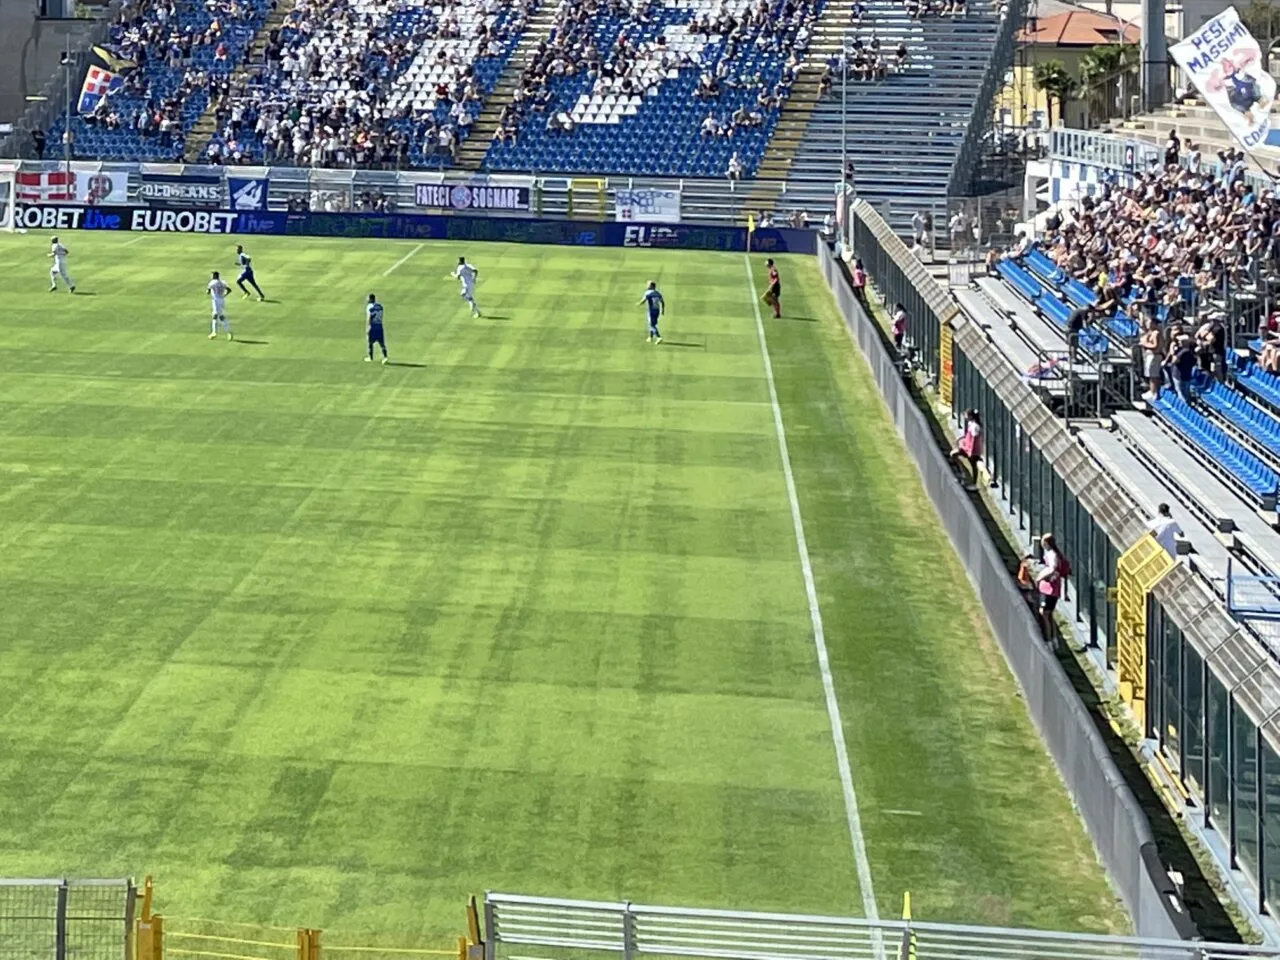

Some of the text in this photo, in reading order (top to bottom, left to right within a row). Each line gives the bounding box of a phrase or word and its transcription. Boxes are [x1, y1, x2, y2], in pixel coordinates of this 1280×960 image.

[1186, 23, 1247, 73] MASSIMI
[1190, 20, 1226, 50] PESI
[416, 185, 450, 206] FATECI
[131, 210, 238, 234] EUROBET
